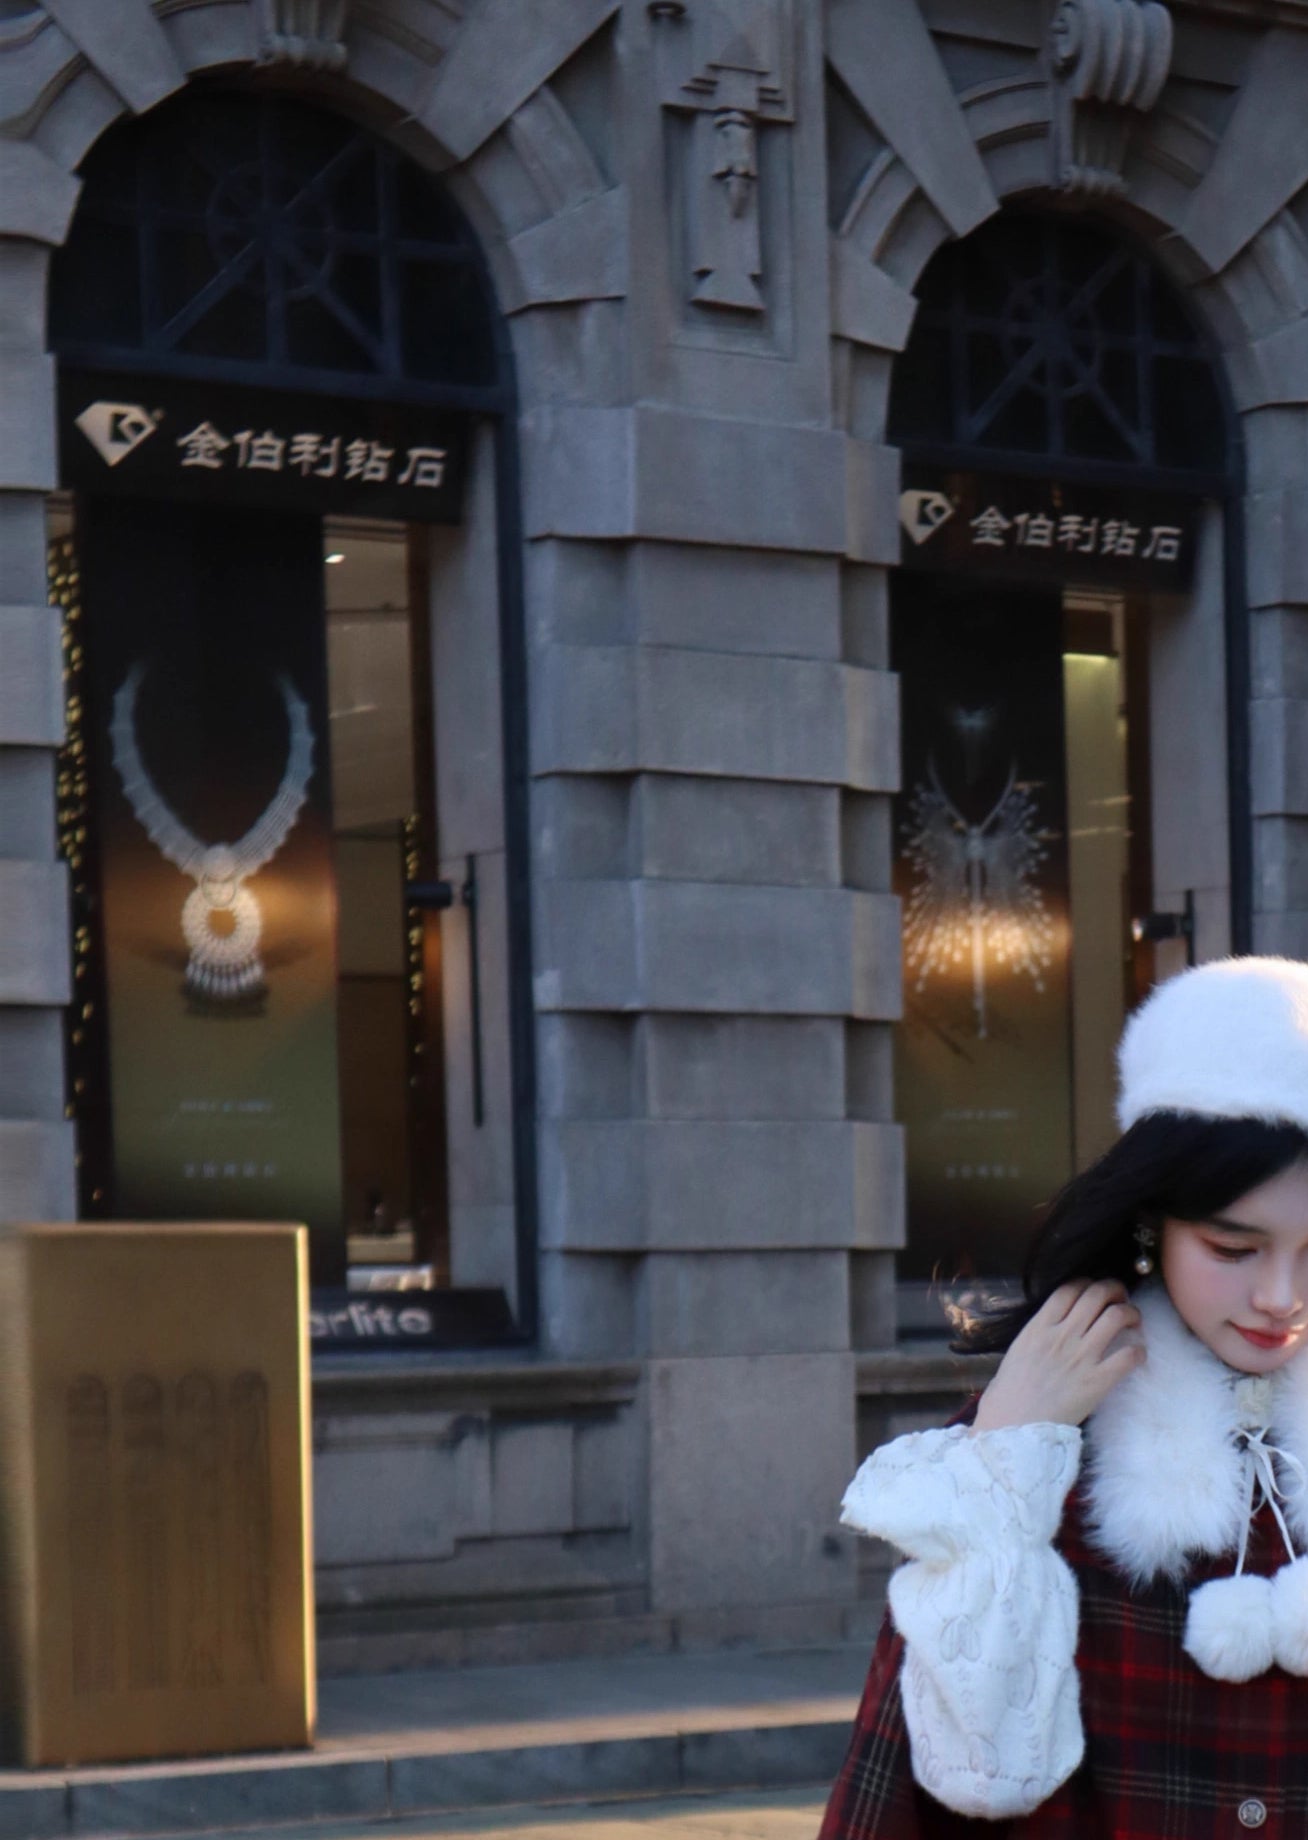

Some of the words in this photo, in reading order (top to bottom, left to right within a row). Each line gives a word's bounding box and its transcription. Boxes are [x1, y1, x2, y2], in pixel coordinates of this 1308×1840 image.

[176, 420, 449, 489] 金伯利钻石
[969, 504, 1183, 561] 金伯利钻石
